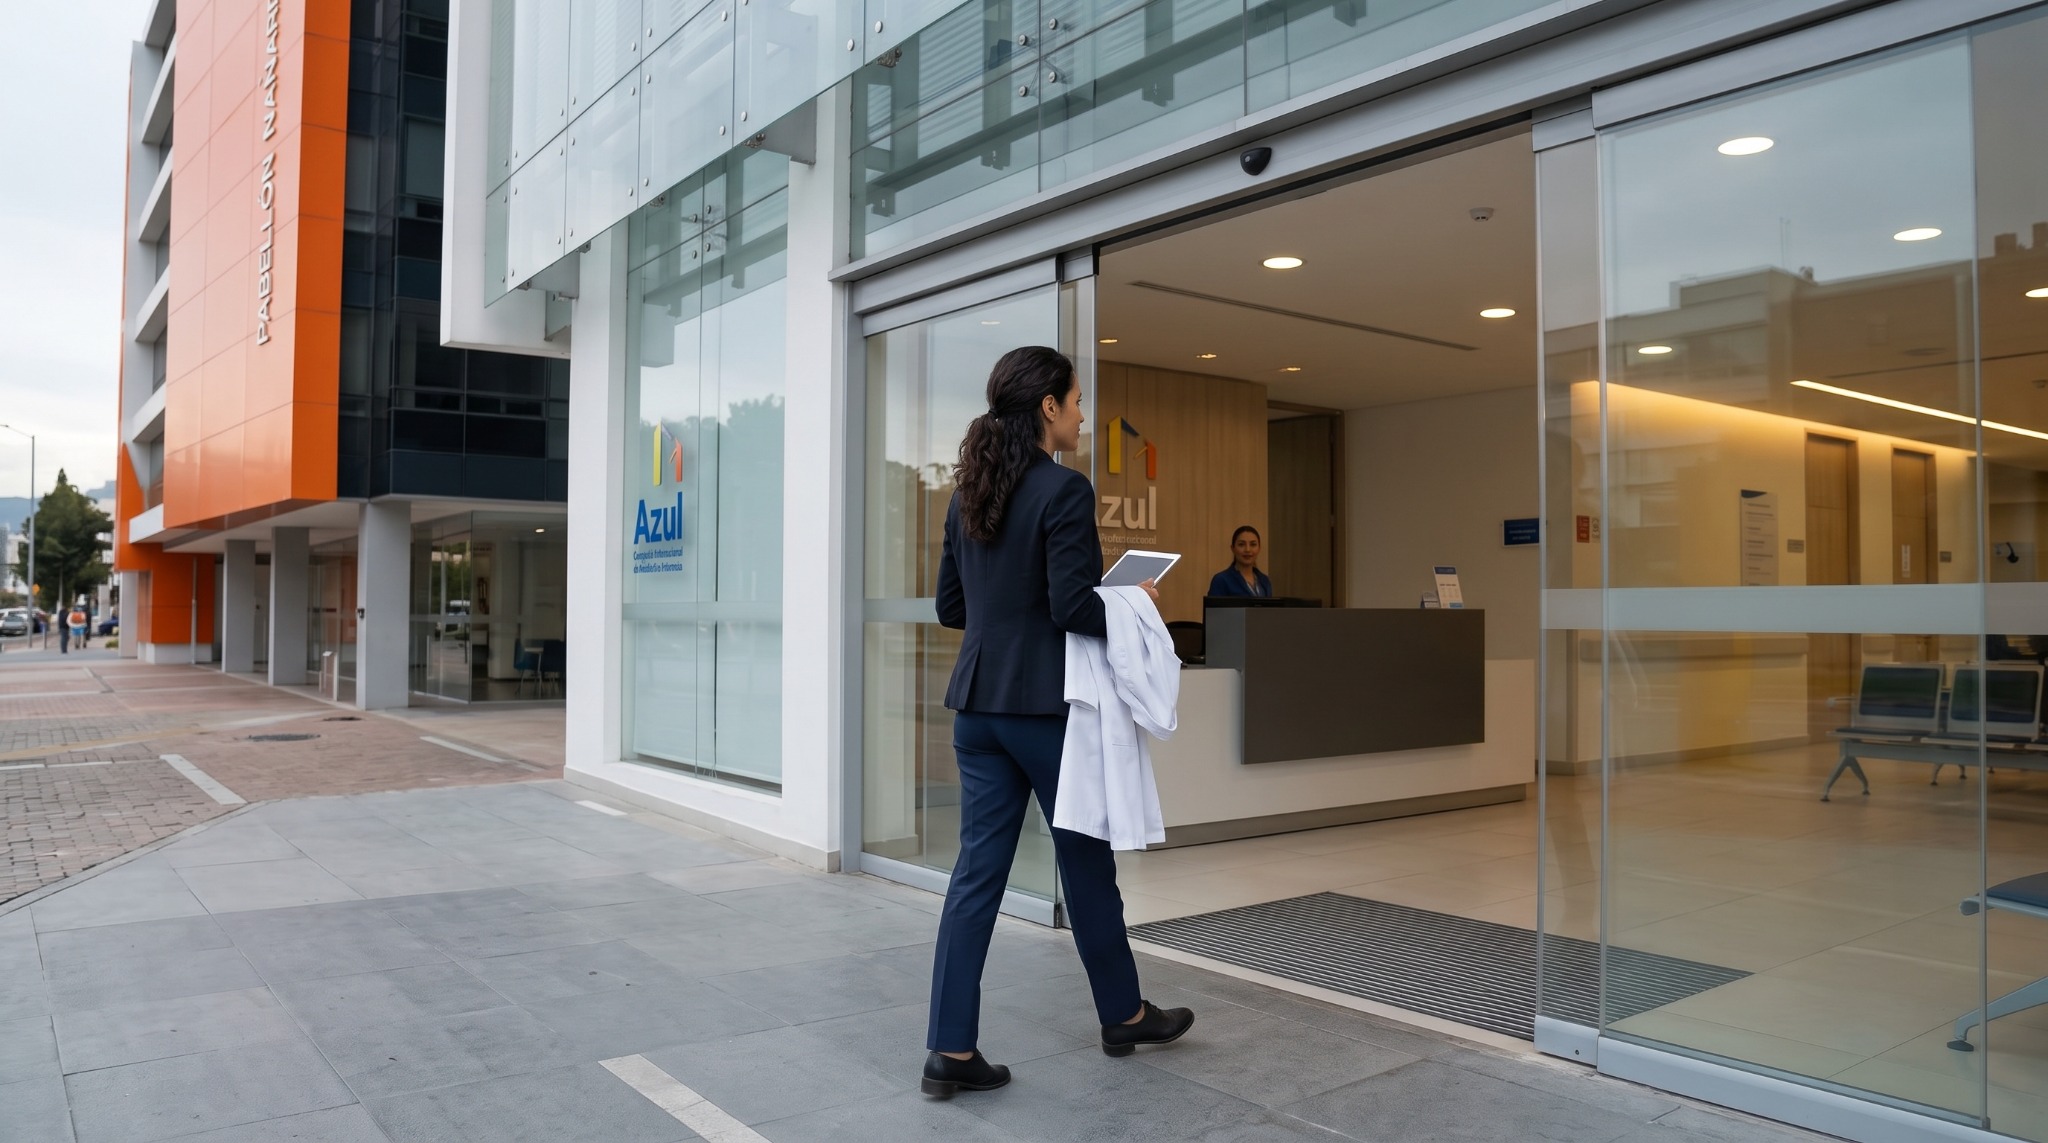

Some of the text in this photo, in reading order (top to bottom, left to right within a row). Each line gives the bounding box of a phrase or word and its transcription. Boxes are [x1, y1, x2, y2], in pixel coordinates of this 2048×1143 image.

[257, 152, 275, 345] PABELLÓN
[633, 491, 683, 545] Azul
[1096, 486, 1157, 530] zul
